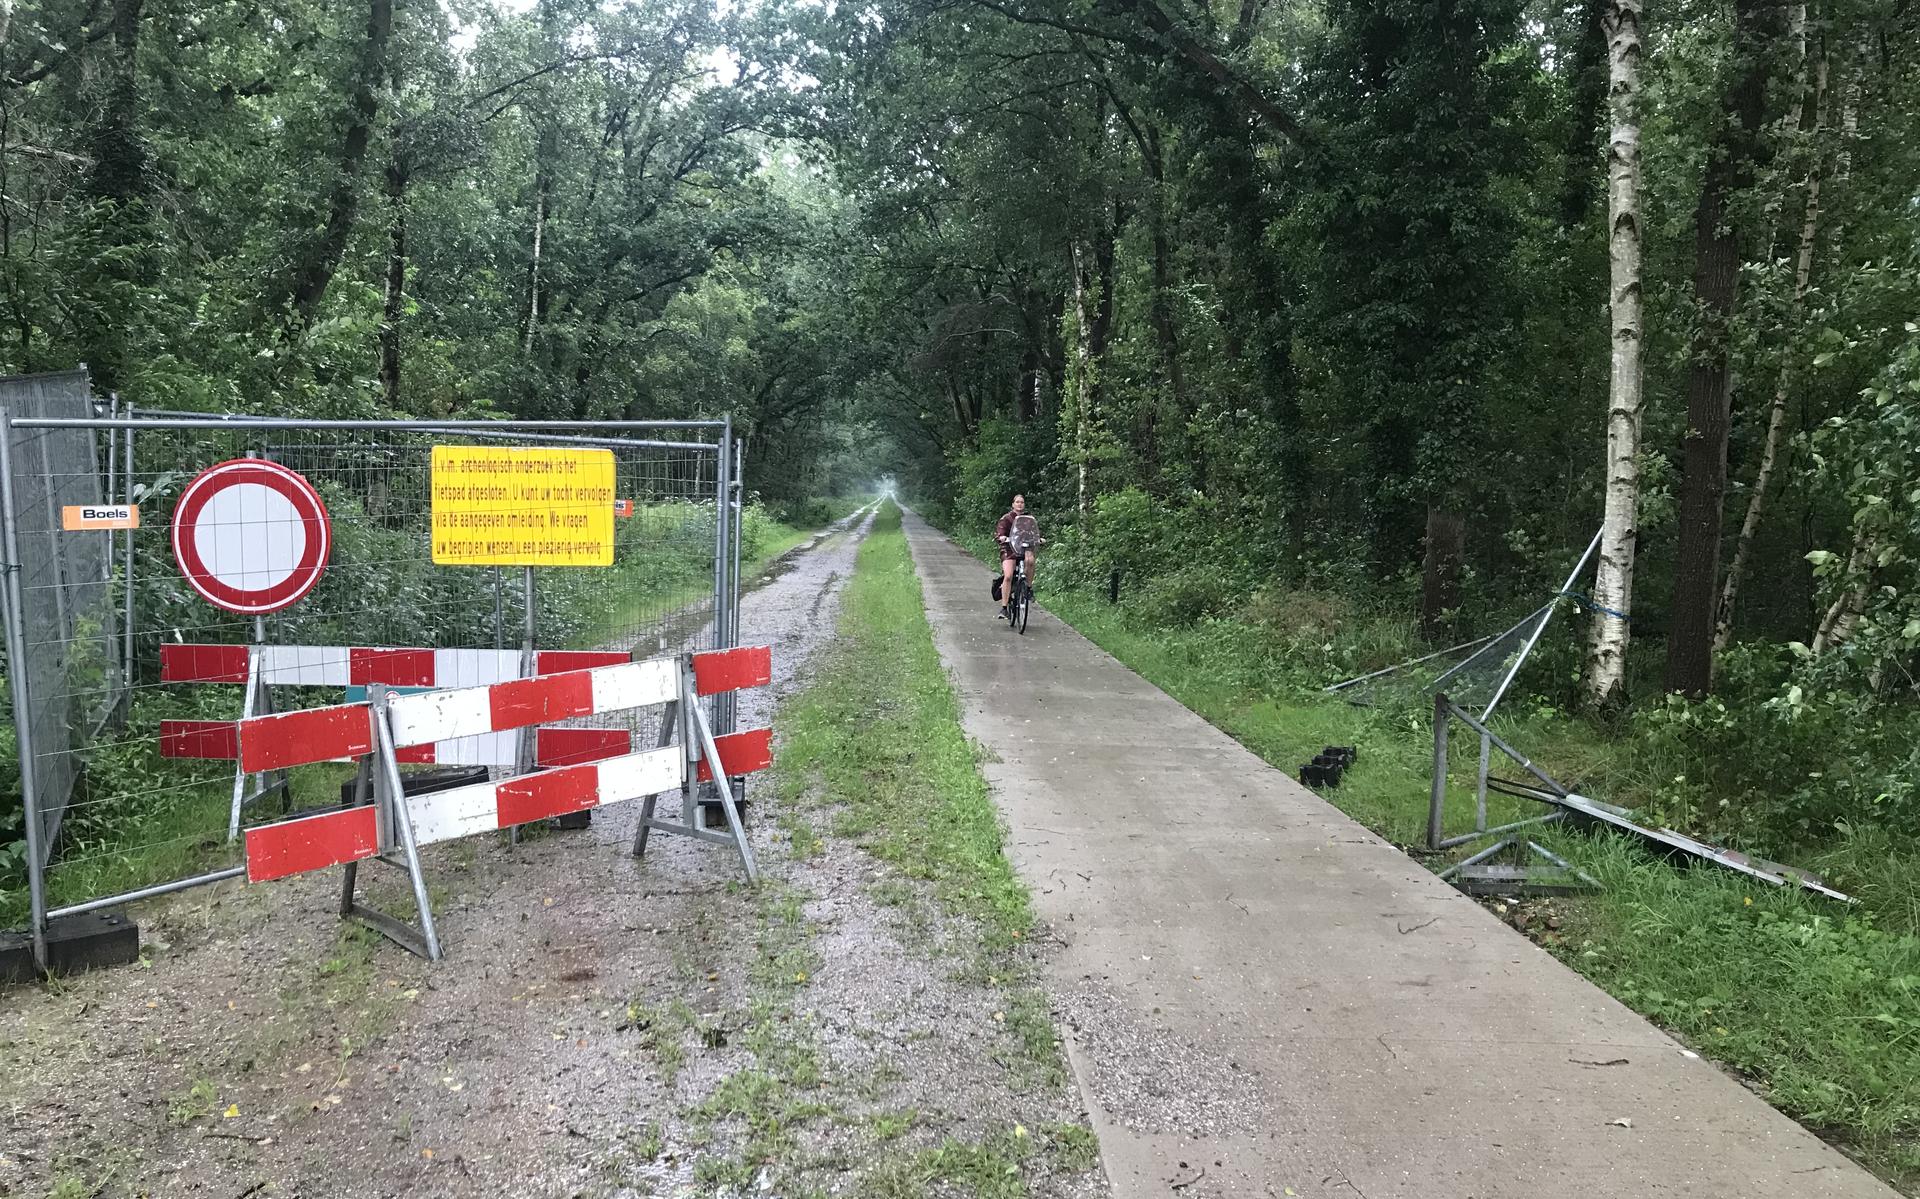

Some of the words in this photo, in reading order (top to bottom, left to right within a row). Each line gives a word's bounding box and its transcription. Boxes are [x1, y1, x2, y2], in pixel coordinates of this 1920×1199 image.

[461, 456, 513, 478] archeologisch
[515, 456, 554, 474] onderzoek
[556, 457, 563, 474] is
[564, 456, 577, 474] het
[434, 482, 466, 504] fietspad
[468, 482, 510, 505] afgesloten.
[513, 483, 519, 501] U
[521, 482, 539, 501] kunt
[541, 487, 551, 501] uw
[553, 483, 573, 501] tocht
[575, 483, 612, 506] vervolgen
[83, 508, 128, 519] Boels
[436, 510, 447, 528] via
[449, 510, 458, 528] de
[460, 513, 505, 533] aangegeven
[549, 510, 560, 528] We
[562, 513, 588, 533] vragen
[436, 541, 446, 555] uw
[449, 537, 472, 560] begrip
[475, 541, 484, 555] en
[487, 541, 513, 555] wensen
[516, 541, 521, 554] u
[523, 541, 535, 555] een
[538, 537, 572, 560] plezierig
[574, 537, 601, 560] vervolg
